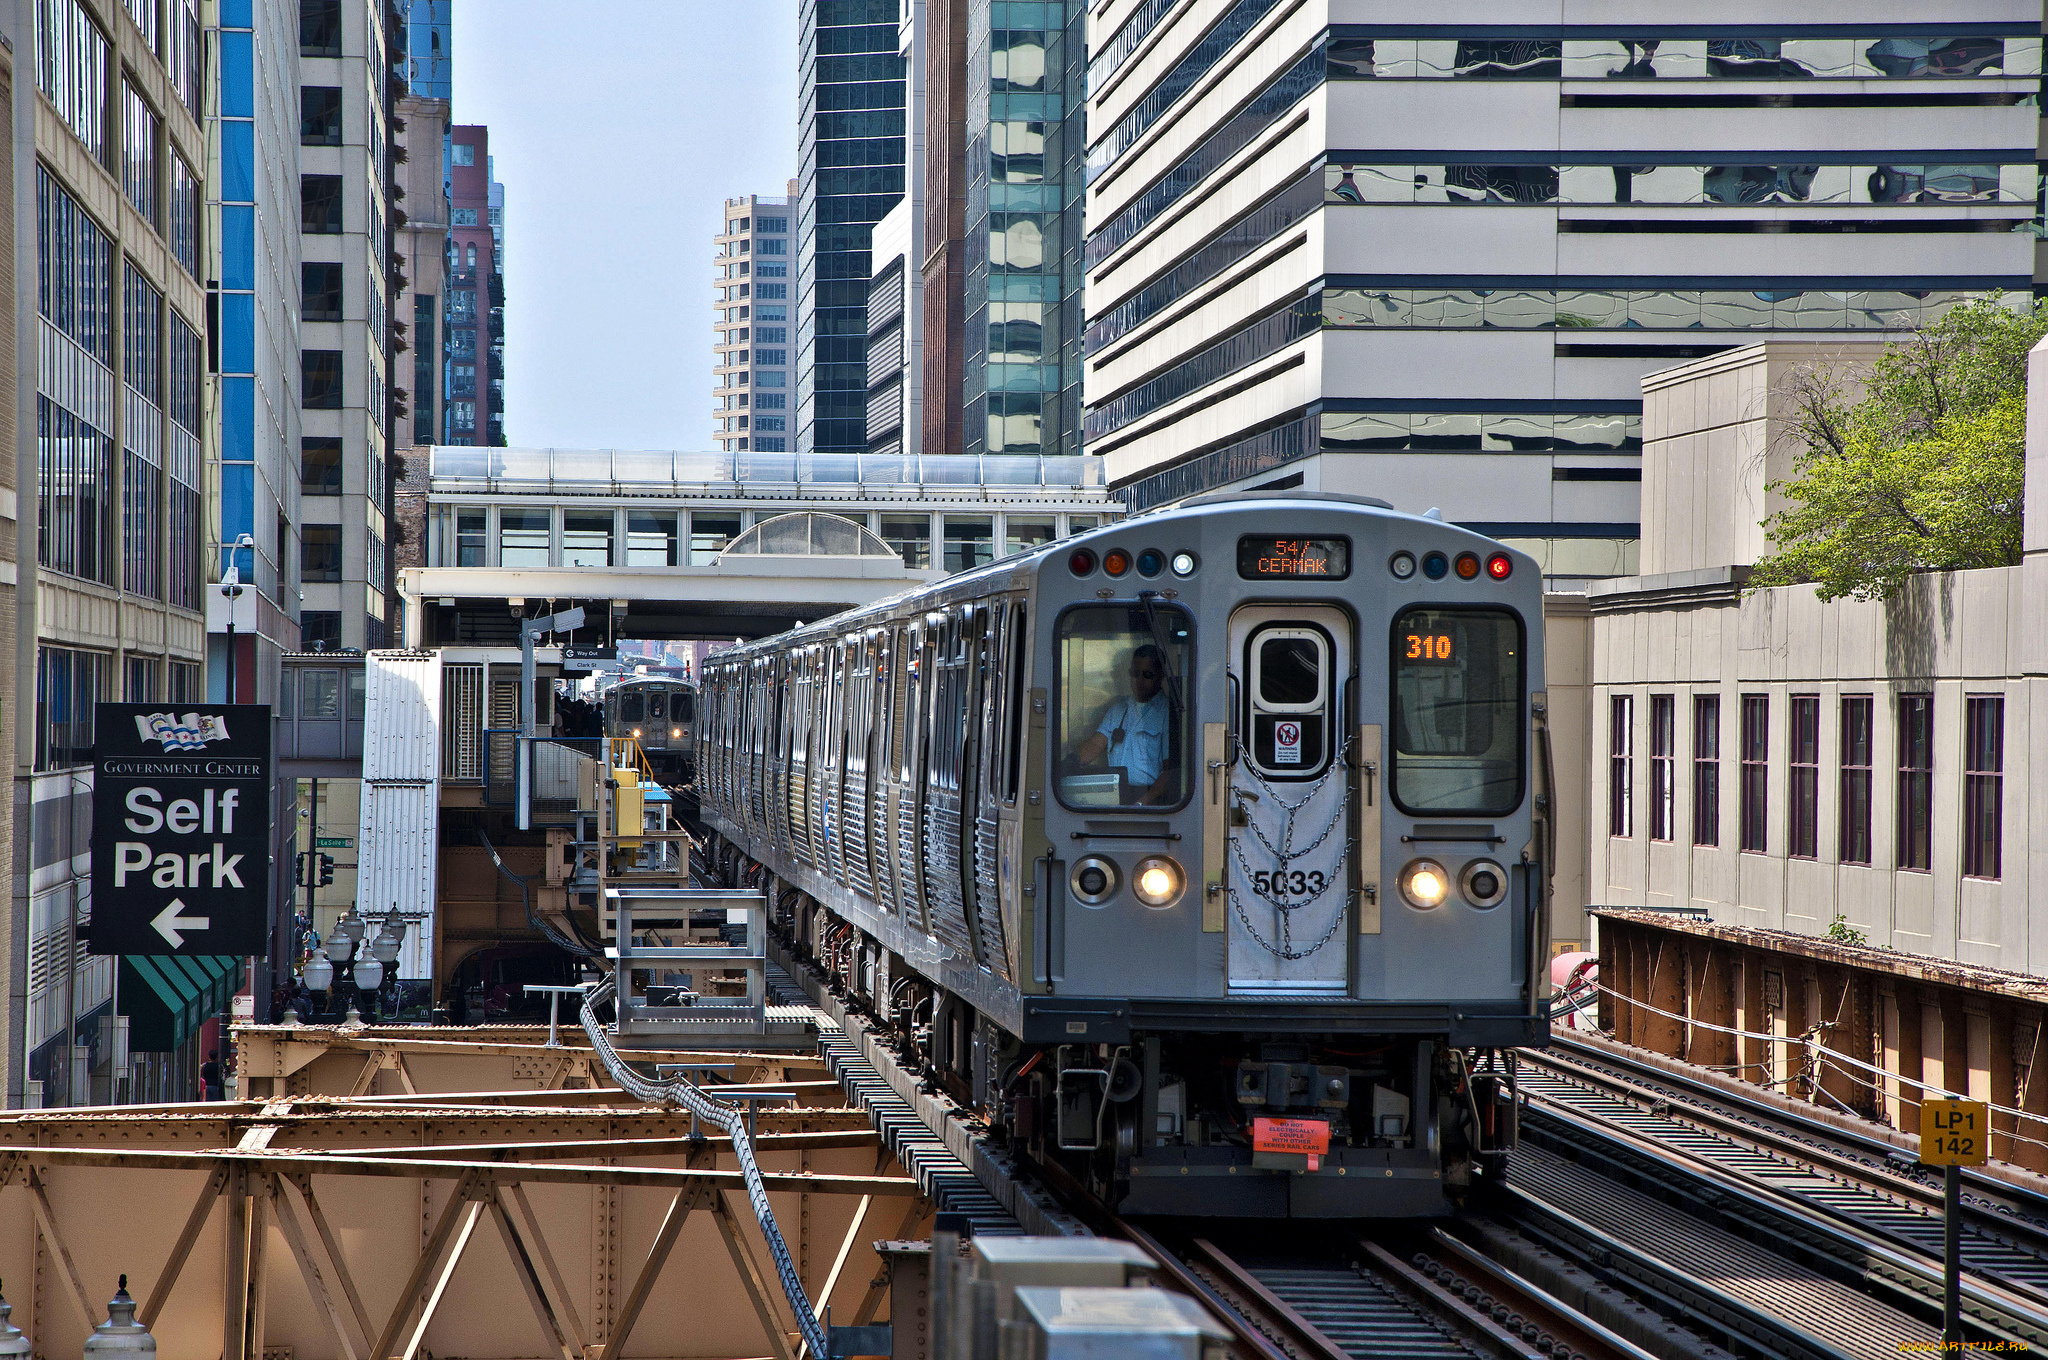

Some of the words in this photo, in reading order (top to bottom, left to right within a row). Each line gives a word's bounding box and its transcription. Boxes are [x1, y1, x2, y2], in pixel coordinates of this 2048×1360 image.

[1258, 558, 1327, 573] CERMAK
[1406, 635, 1451, 659] 310
[103, 760, 201, 774] GOVERNMENT
[205, 761, 260, 775] CENTER
[124, 786, 239, 834] Self
[114, 841, 245, 888] Park
[1252, 870, 1325, 895] 5033
[1935, 1111, 1974, 1130] LP1
[1934, 1137, 1974, 1155] 142
